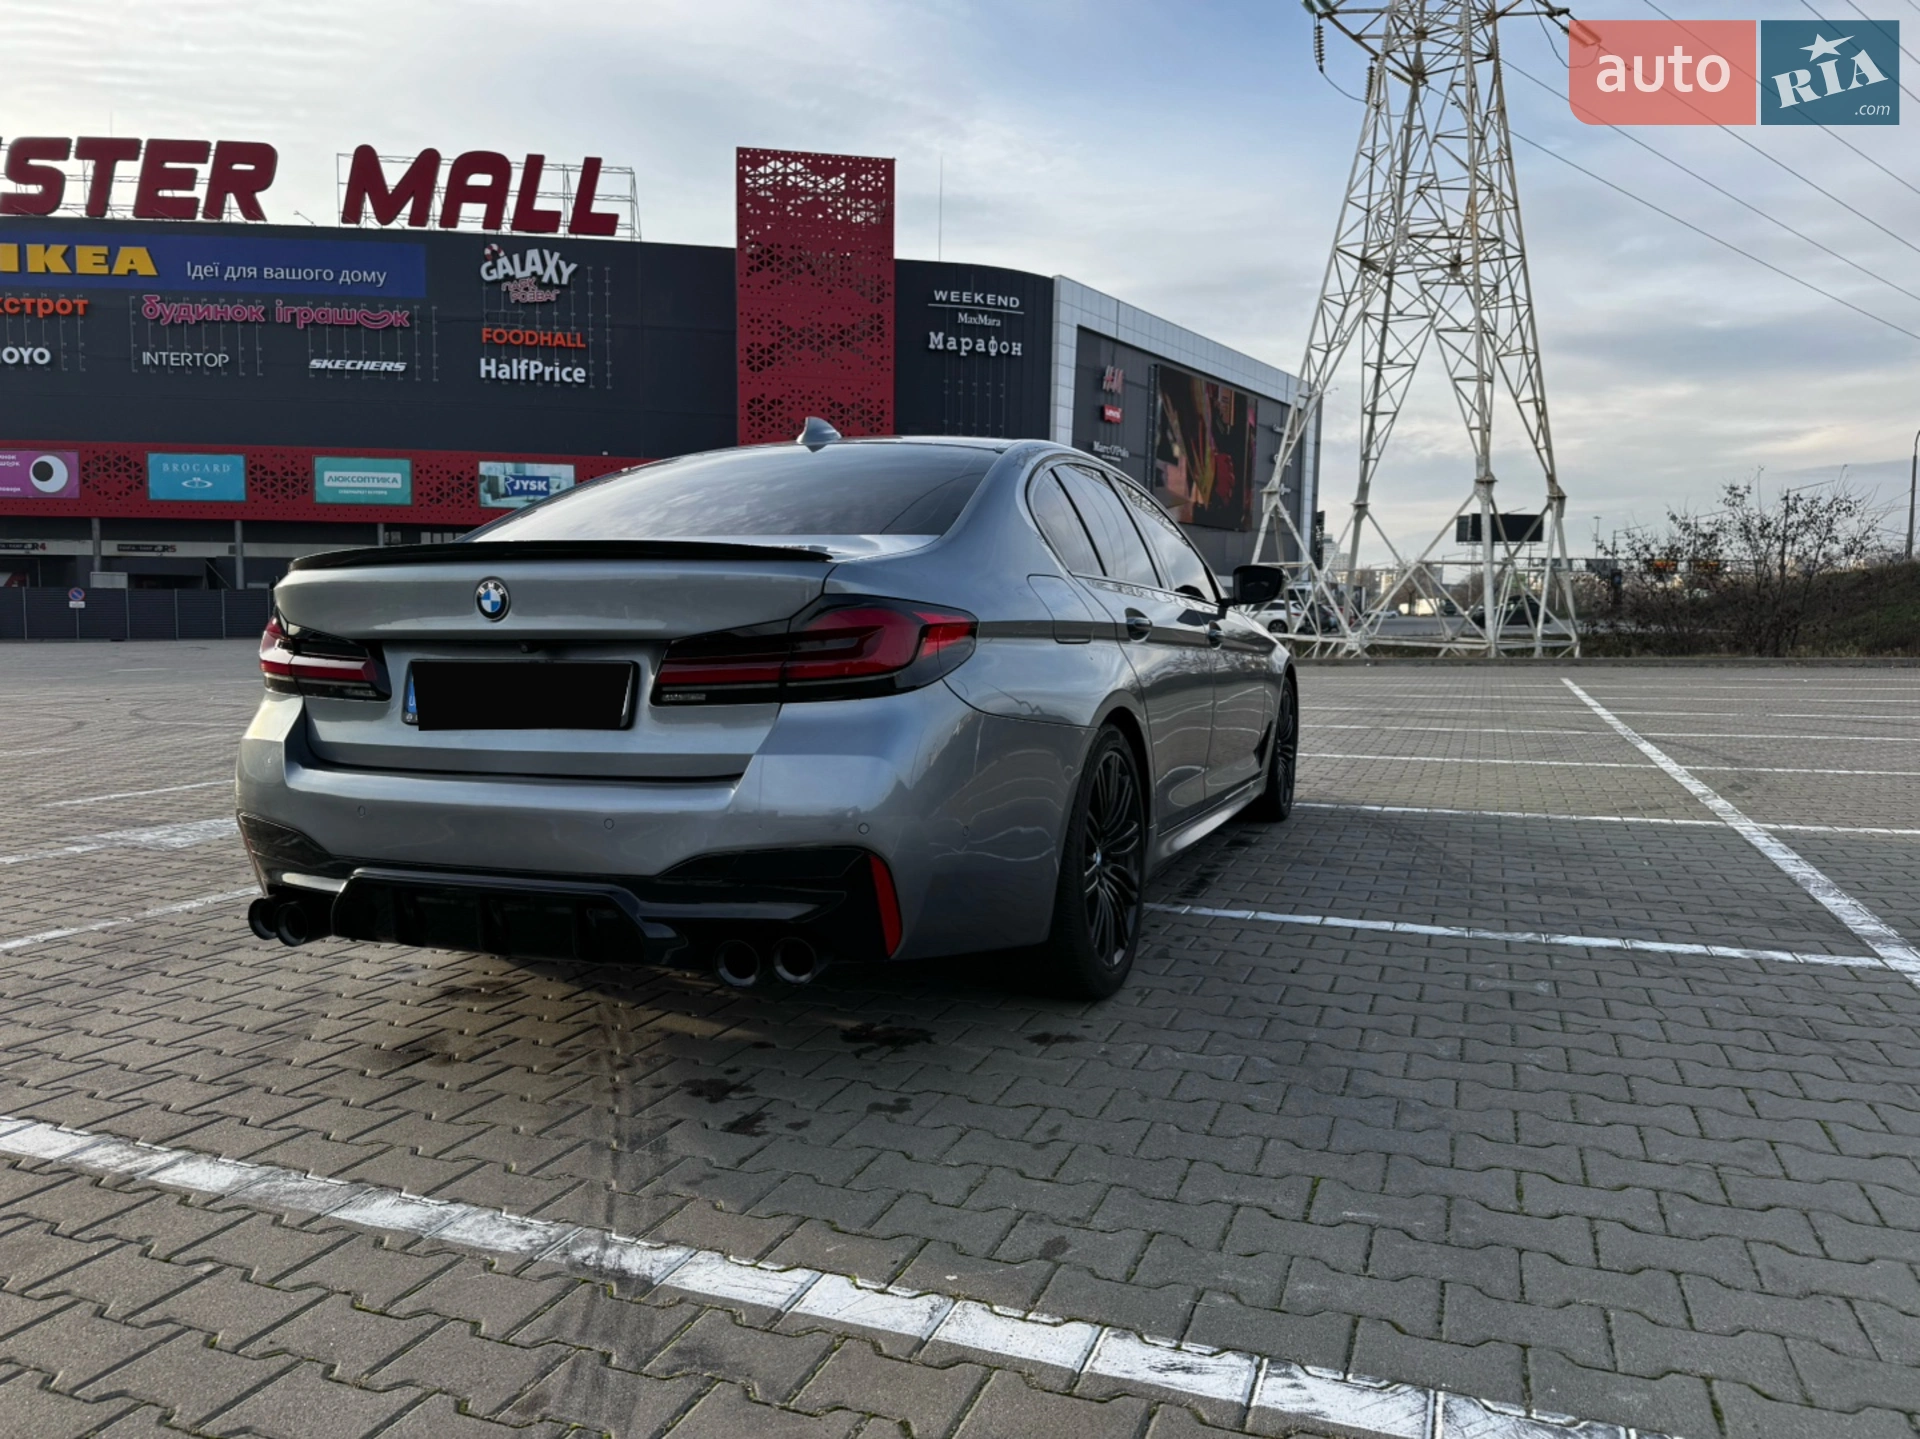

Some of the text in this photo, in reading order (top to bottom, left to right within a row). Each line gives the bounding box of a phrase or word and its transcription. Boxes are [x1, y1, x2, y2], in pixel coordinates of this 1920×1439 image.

[0, 136, 619, 236] STER MALL
[0, 243, 158, 275] IKEA
[480, 248, 578, 285] GALAXY
[187, 261, 387, 288] Ідеї для вашого дому
[0, 297, 89, 318] строт
[934, 290, 1020, 308] WEEKEND
[142, 294, 265, 325] будинок
[957, 312, 1001, 327] MaxMara
[482, 328, 586, 348] FOODHALL
[928, 331, 1023, 356] Марафон
[0, 346, 51, 365] OYO
[142, 351, 230, 367] INTERTOP
[308, 358, 407, 372] SKECHERS
[480, 357, 586, 383] HalfPrice
[162, 462, 230, 473] BROCARD
[327, 475, 399, 484] ЛЮКСОПТИКА
[513, 479, 548, 491] JYSK
